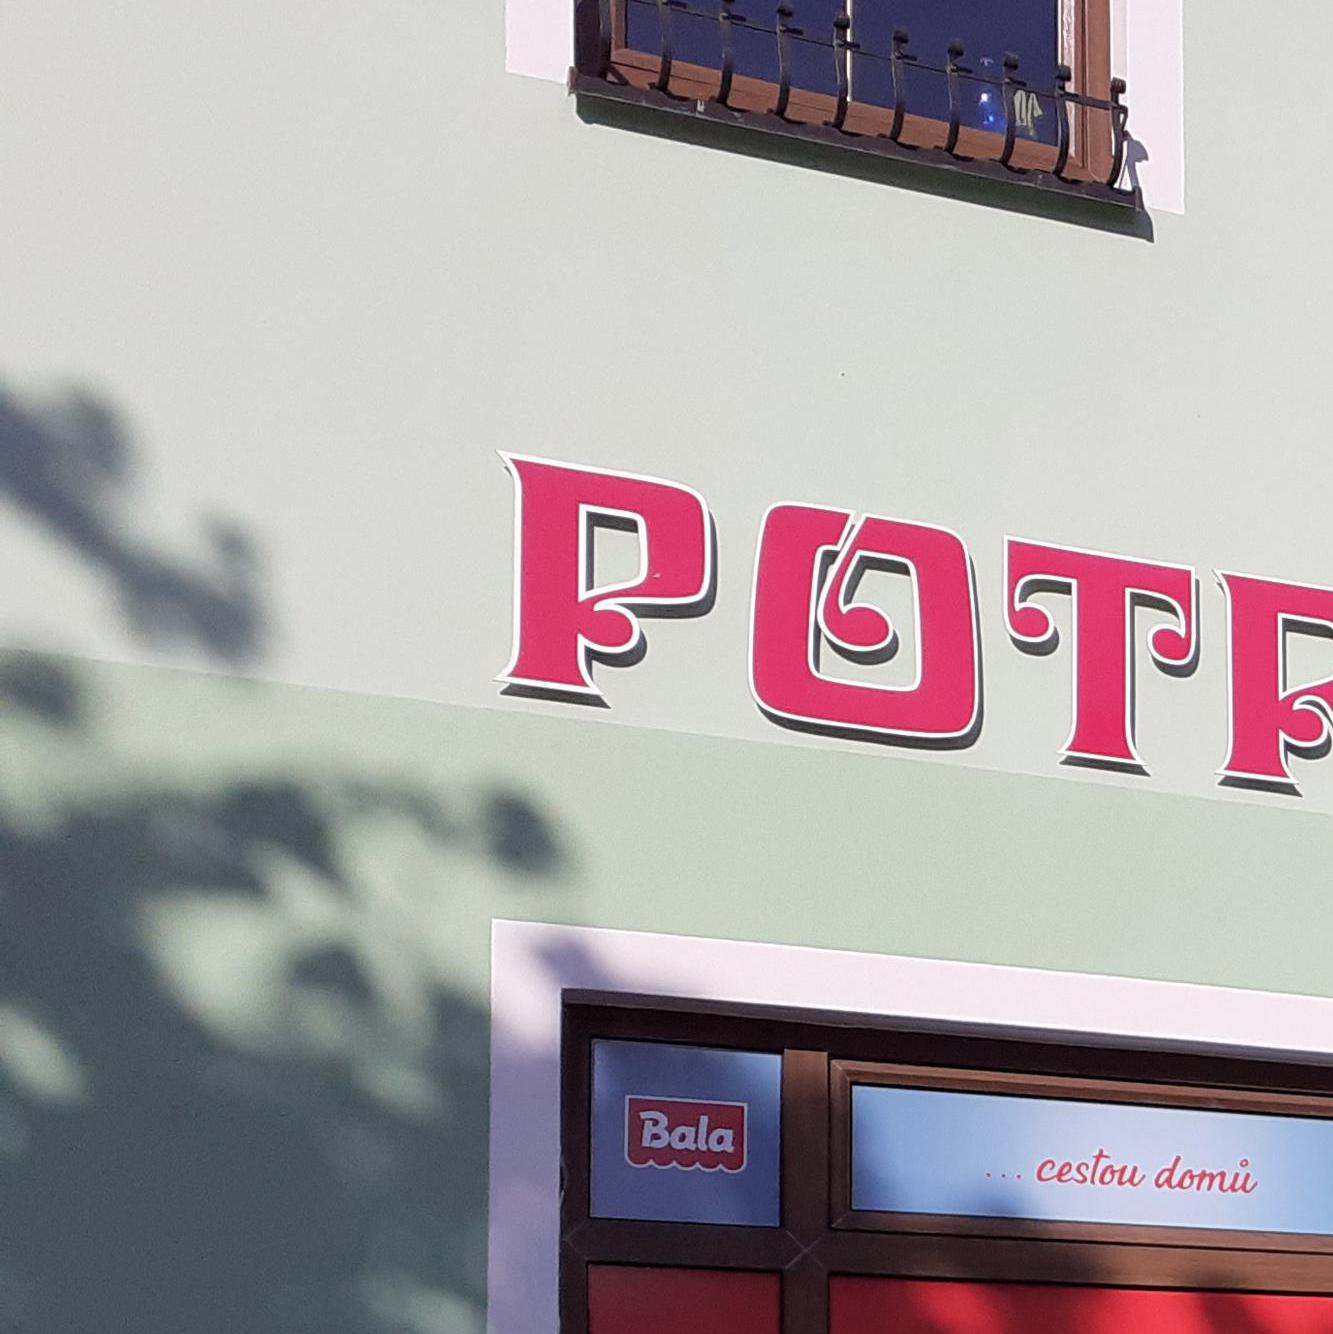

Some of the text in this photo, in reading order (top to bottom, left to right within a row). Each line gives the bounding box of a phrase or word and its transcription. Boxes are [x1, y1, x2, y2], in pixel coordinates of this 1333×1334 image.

[639, 1110, 735, 1153] Bala
[1035, 1148, 1146, 1187] cestou
[1154, 1154, 1258, 1193] domů
